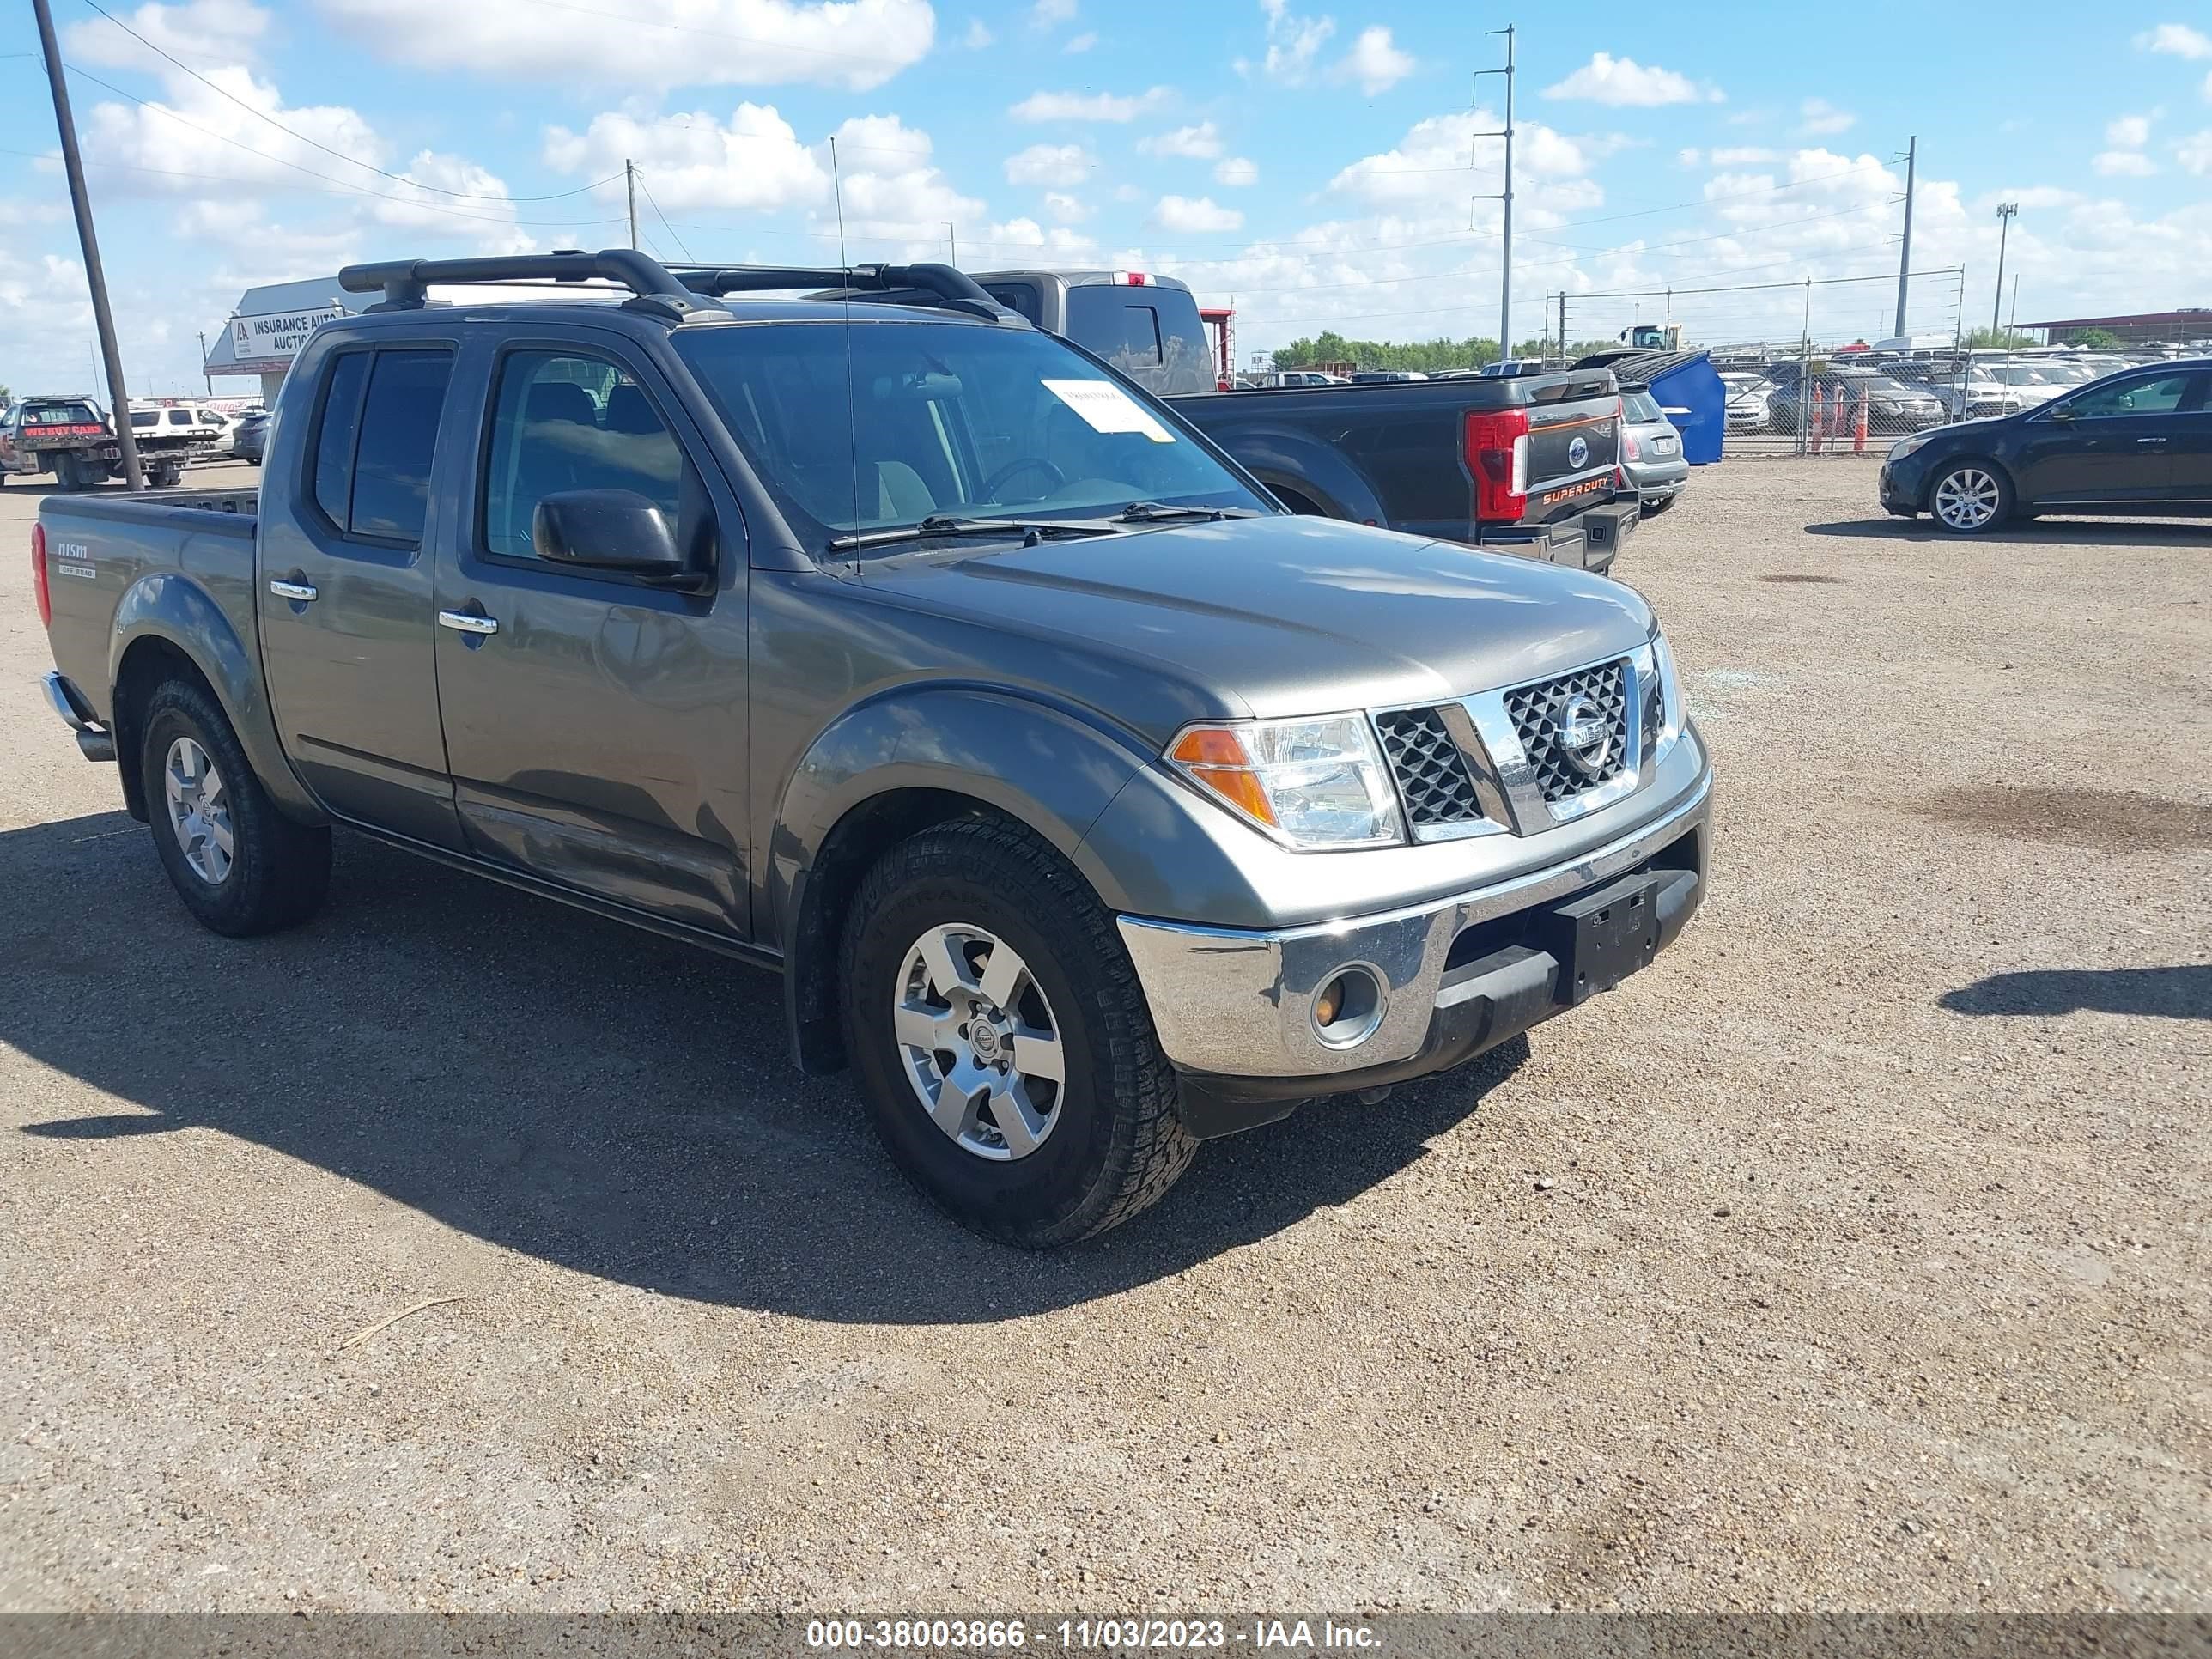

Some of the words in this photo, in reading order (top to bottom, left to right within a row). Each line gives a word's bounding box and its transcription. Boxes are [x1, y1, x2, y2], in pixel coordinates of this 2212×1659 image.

[254, 316, 309, 335] INSURANCE
[274, 333, 309, 350] AUCTIO
[25, 428, 46, 436] WE
[47, 426, 70, 436] BUY
[71, 425, 101, 434] CARS
[1543, 483, 1583, 505] SUPER
[1583, 477, 1608, 492] DUTY
